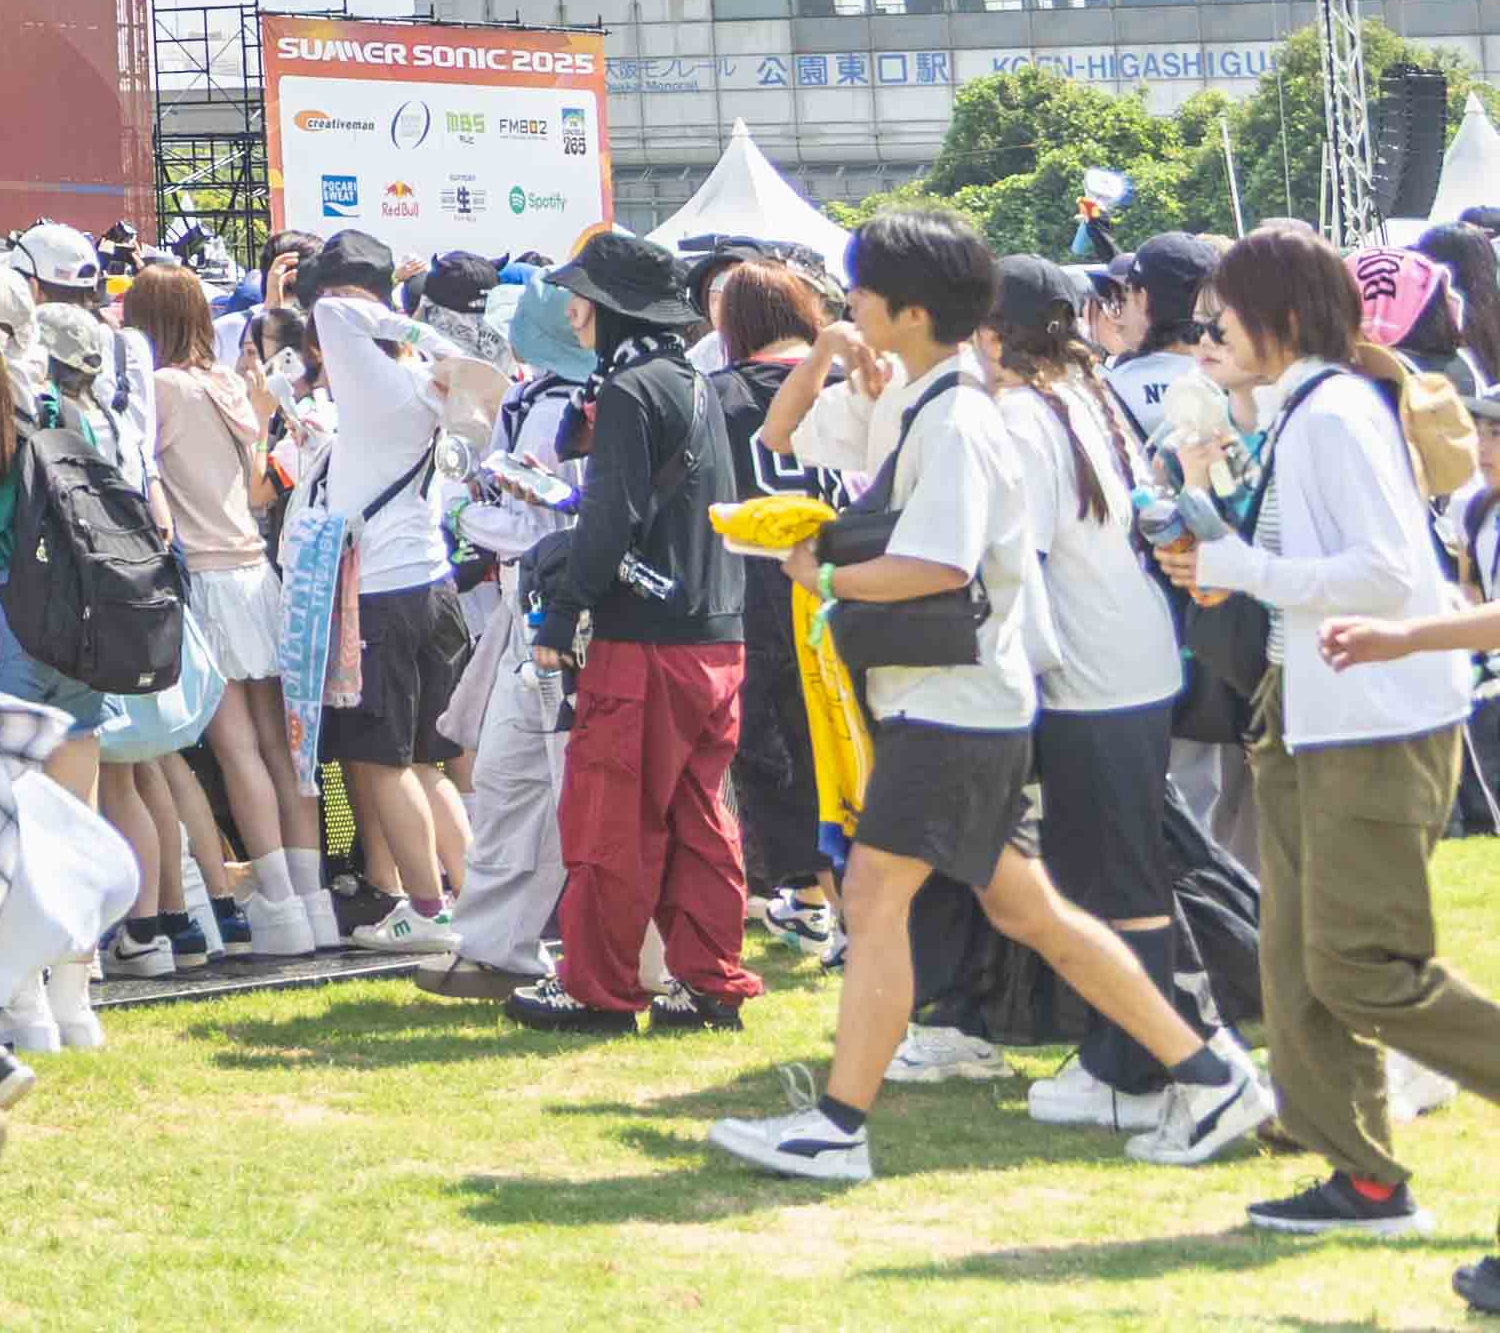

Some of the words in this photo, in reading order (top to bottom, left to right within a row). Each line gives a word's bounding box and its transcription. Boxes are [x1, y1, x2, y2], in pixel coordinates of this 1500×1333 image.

[277, 37, 407, 65] SUMMER
[412, 45, 508, 70] SONIC
[512, 50, 594, 74] 2025
[756, 52, 949, 86] 公園東口駅
[307, 118, 375, 131] creativeman
[322, 180, 357, 192] POCARI
[527, 191, 567, 213] Spotify
